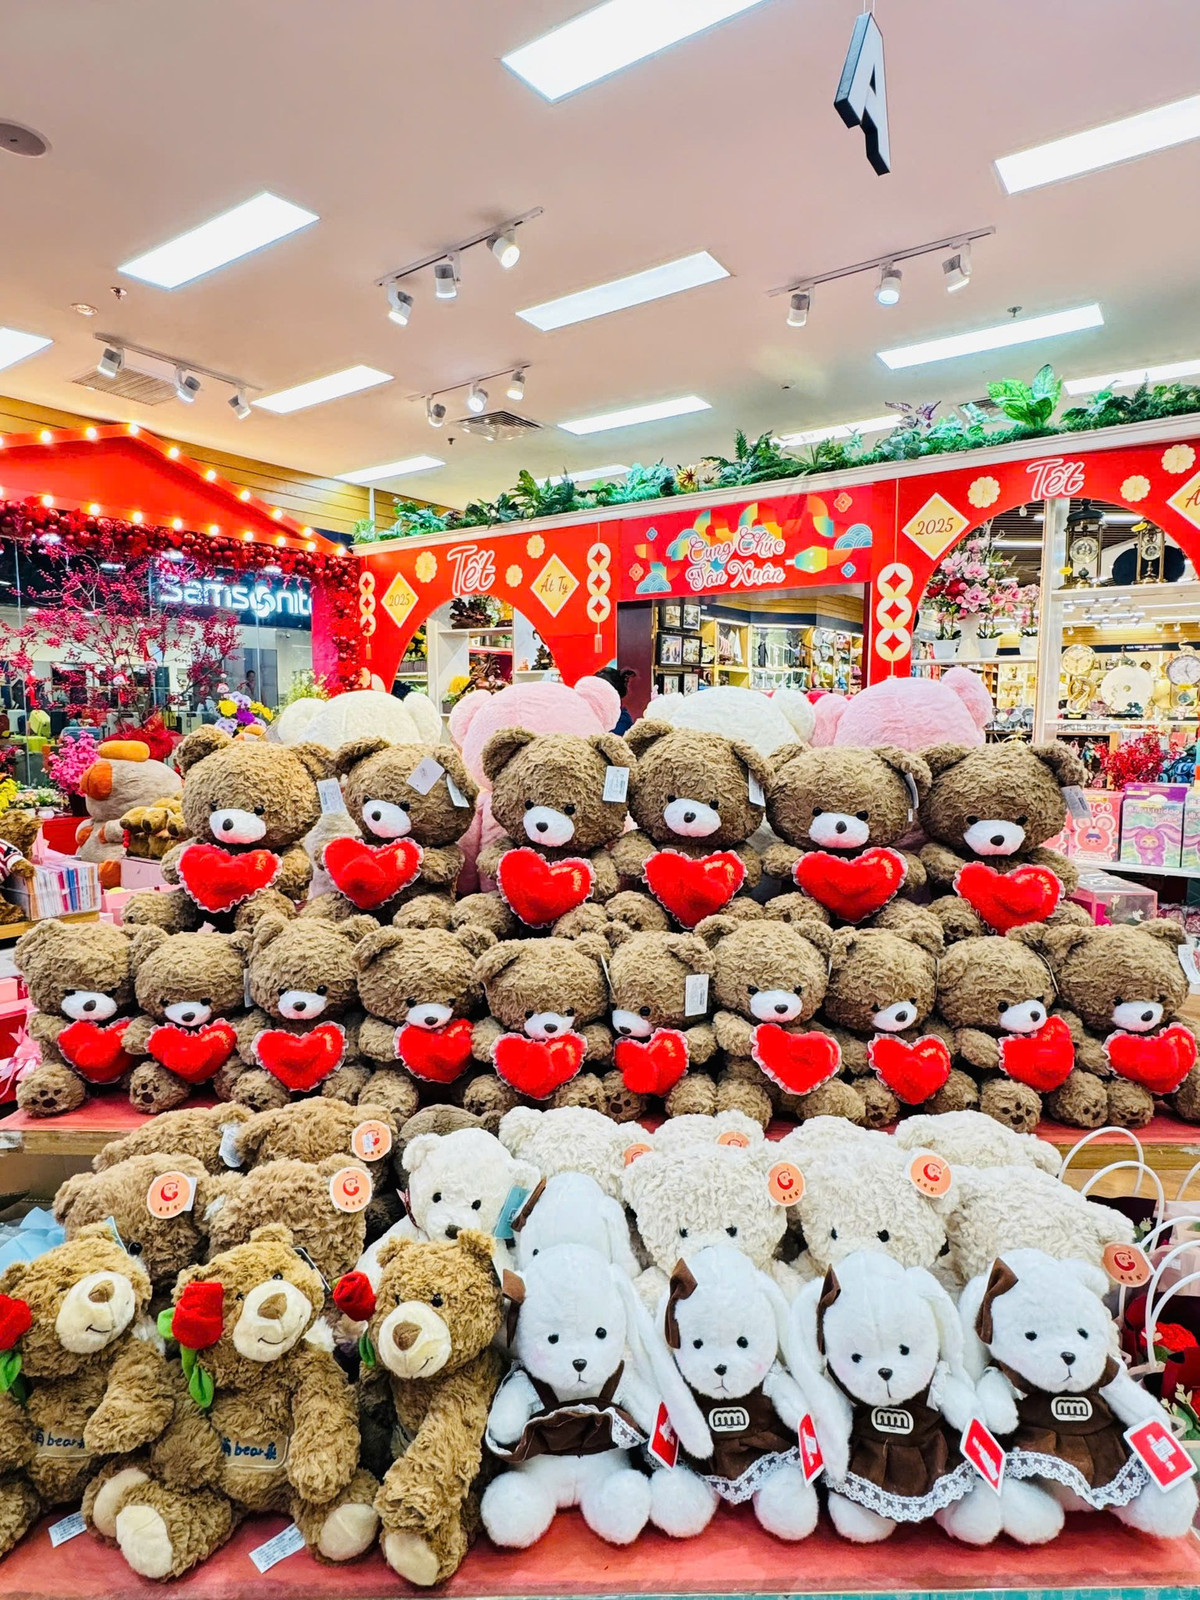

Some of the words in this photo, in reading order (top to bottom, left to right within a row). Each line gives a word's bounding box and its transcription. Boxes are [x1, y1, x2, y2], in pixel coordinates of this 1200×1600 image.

[834, 11, 890, 175] A
[1025, 458, 1085, 501] Tết
[688, 534, 734, 564] Cung
[736, 525, 786, 558] Chúc
[915, 517, 954, 535] 2025
[447, 544, 496, 597] Tết
[685, 561, 728, 591] Tân
[727, 560, 786, 588] Xuân
[159, 574, 313, 618] Samsonit
[388, 592, 411, 607] 2025
